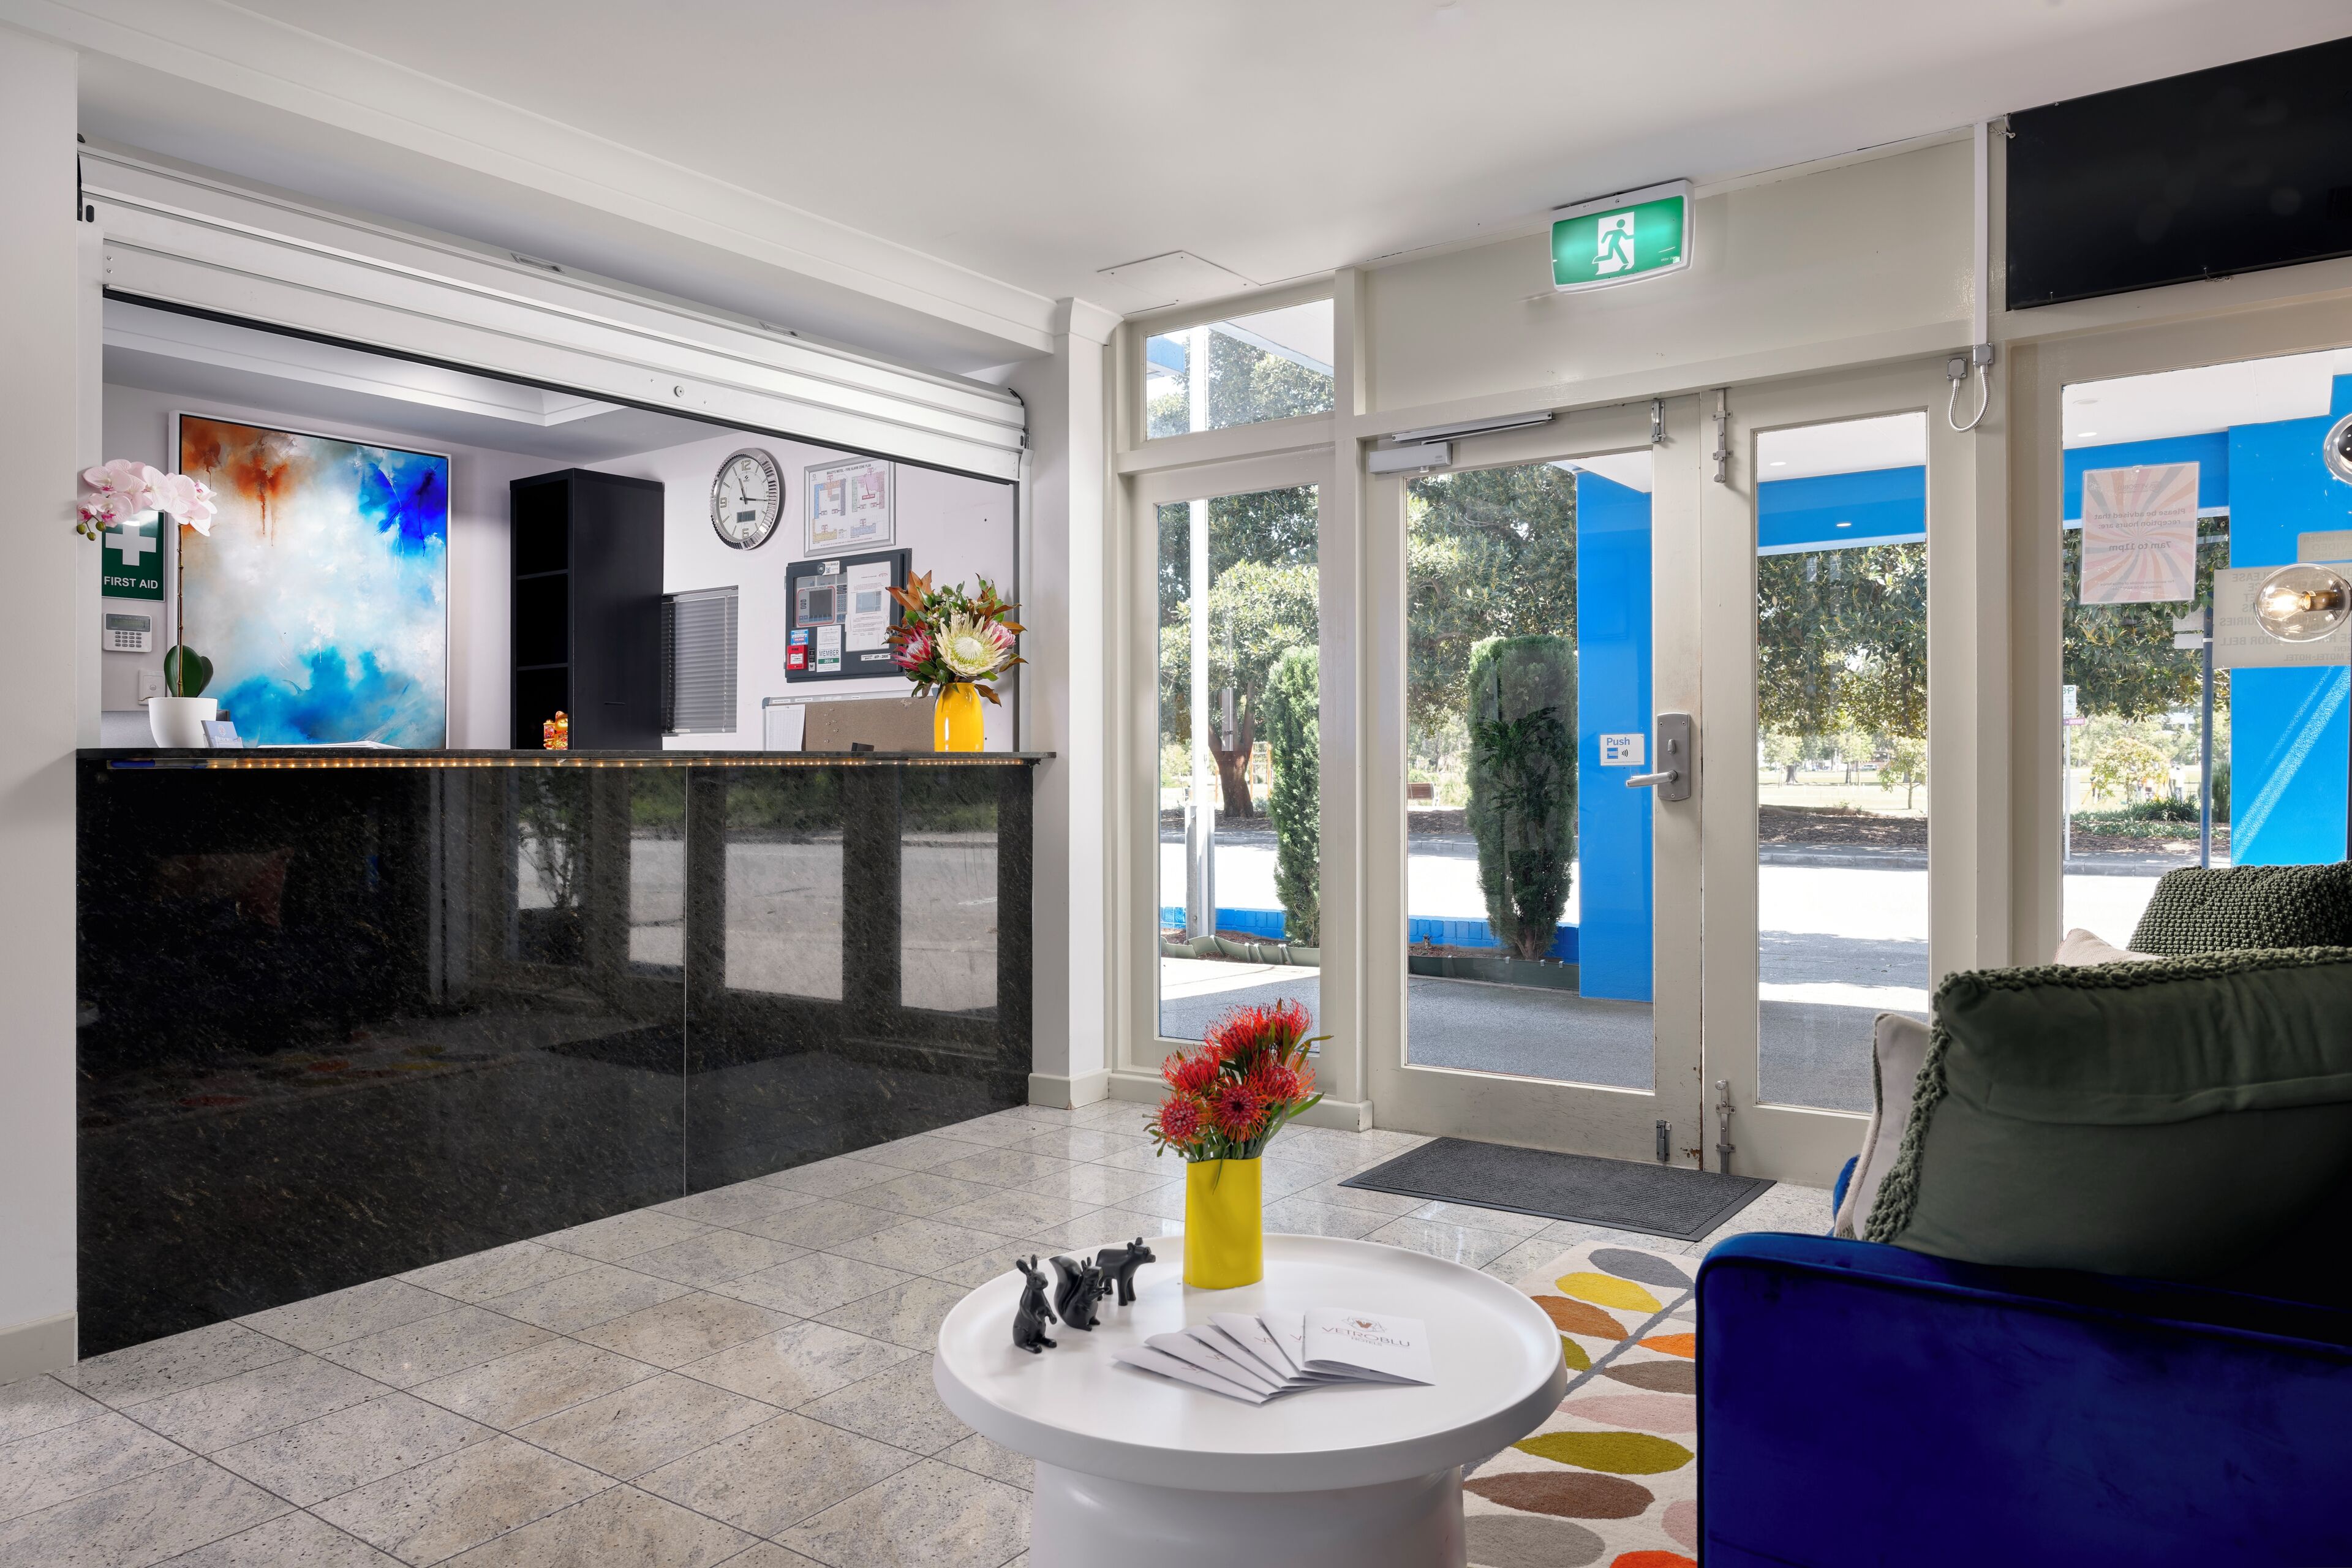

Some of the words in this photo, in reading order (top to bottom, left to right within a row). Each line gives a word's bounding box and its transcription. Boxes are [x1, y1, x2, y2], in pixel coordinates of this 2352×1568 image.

[741, 460, 751, 471] 12
[720, 497, 727, 508] 9
[742, 528, 749, 539] 6
[104, 576, 137, 587] FIRST
[139, 579, 158, 589] AID
[1606, 737, 1630, 745] Push
[1321, 1326, 1410, 1347] VETROBLU
[1351, 1336, 1382, 1346] HOTELS
